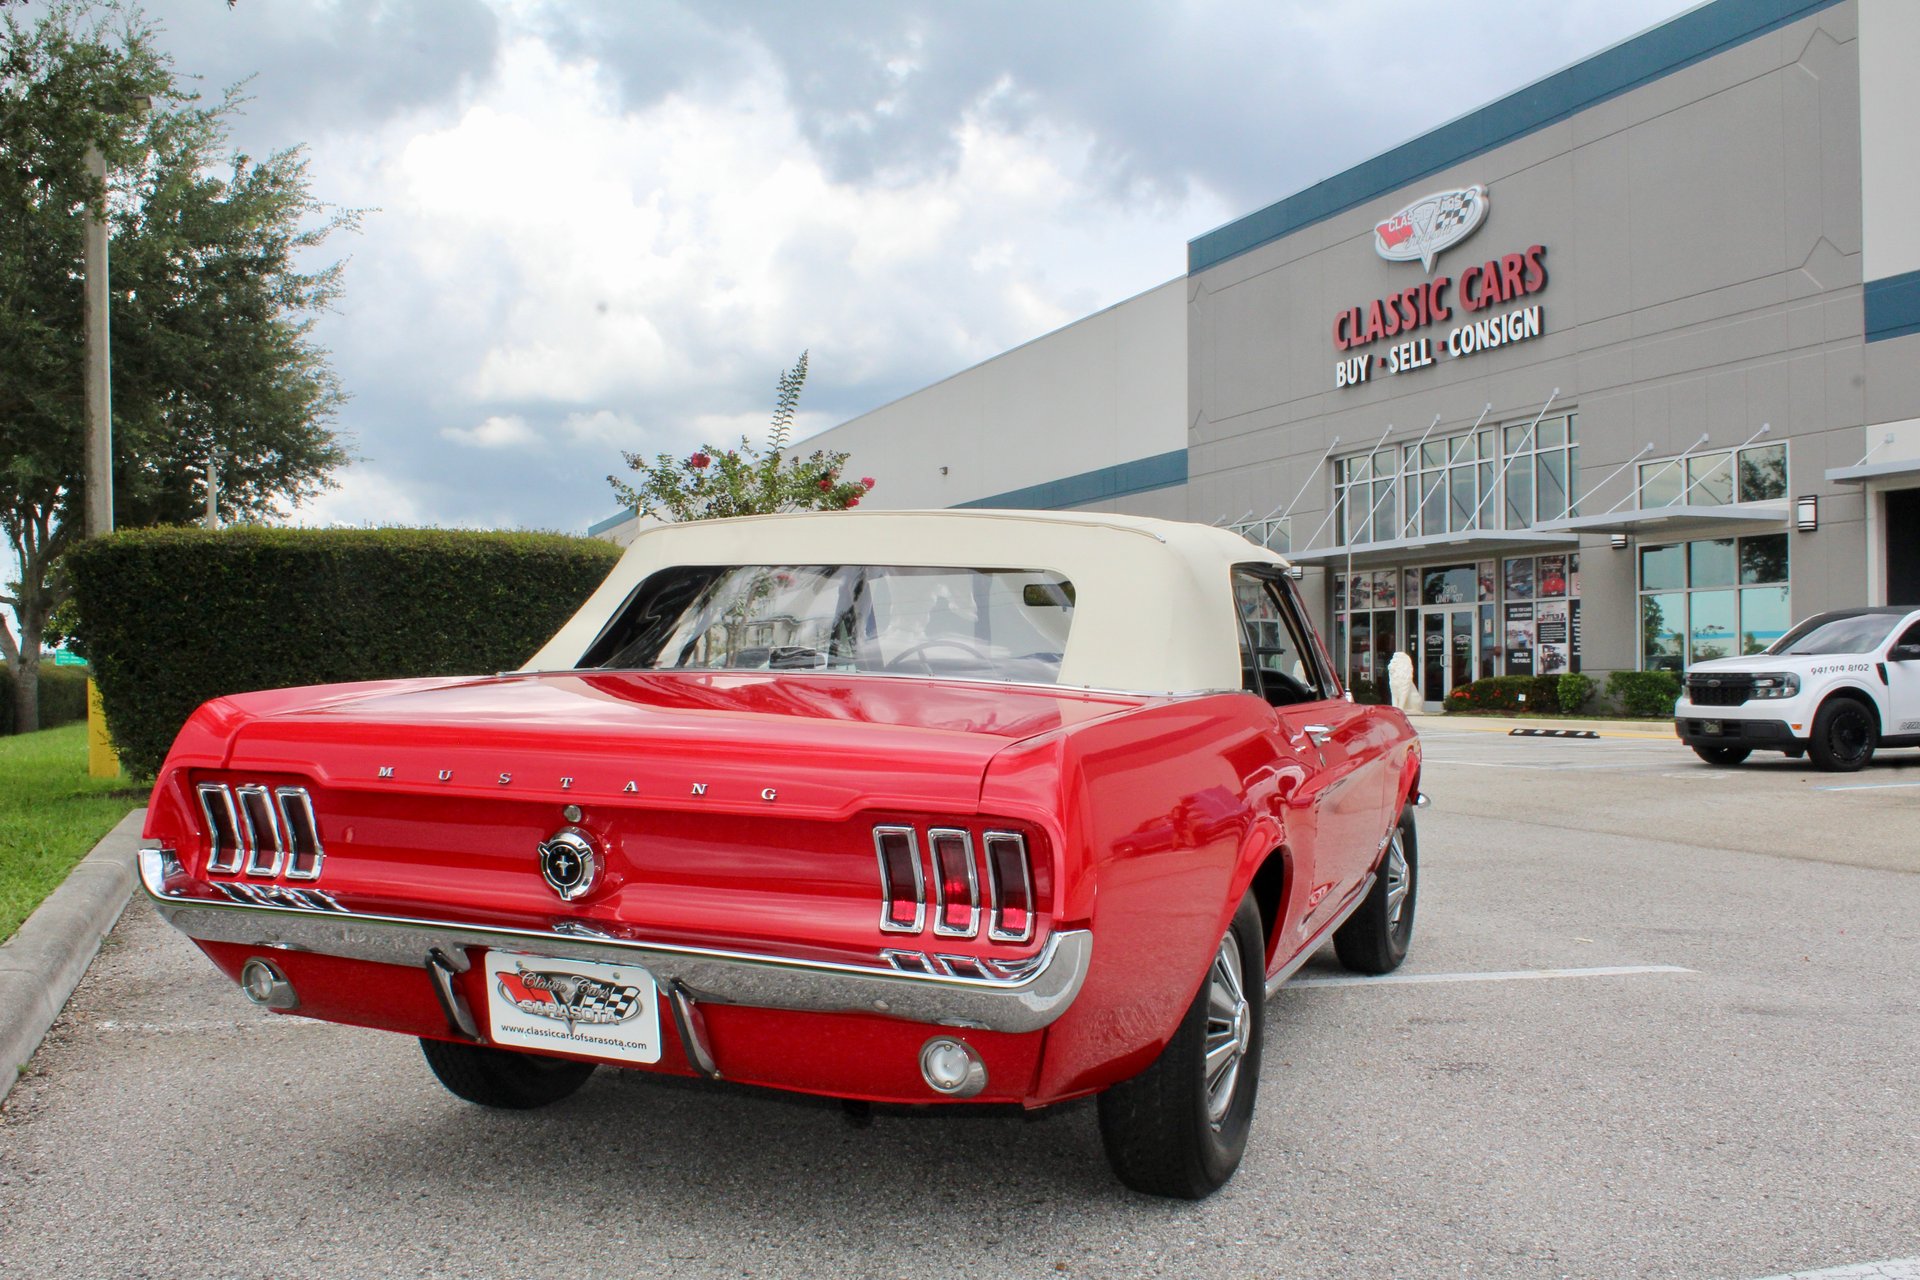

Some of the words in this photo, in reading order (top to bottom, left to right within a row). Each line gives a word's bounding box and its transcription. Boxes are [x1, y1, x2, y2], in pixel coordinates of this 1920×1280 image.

[1333, 276, 1450, 351] CLASSIC
[1459, 244, 1546, 313] CARS
[1336, 354, 1370, 388] BUY
[1390, 338, 1432, 374] SELL
[1449, 305, 1541, 358] CONSIGN
[378, 766, 777, 801] MUSTANG
[518, 968, 568, 994] Classic
[571, 975, 613, 998] Cars
[521, 999, 620, 1026] SARASOTA
[501, 1023, 648, 1050] www.classiccarsofsarasota.com
